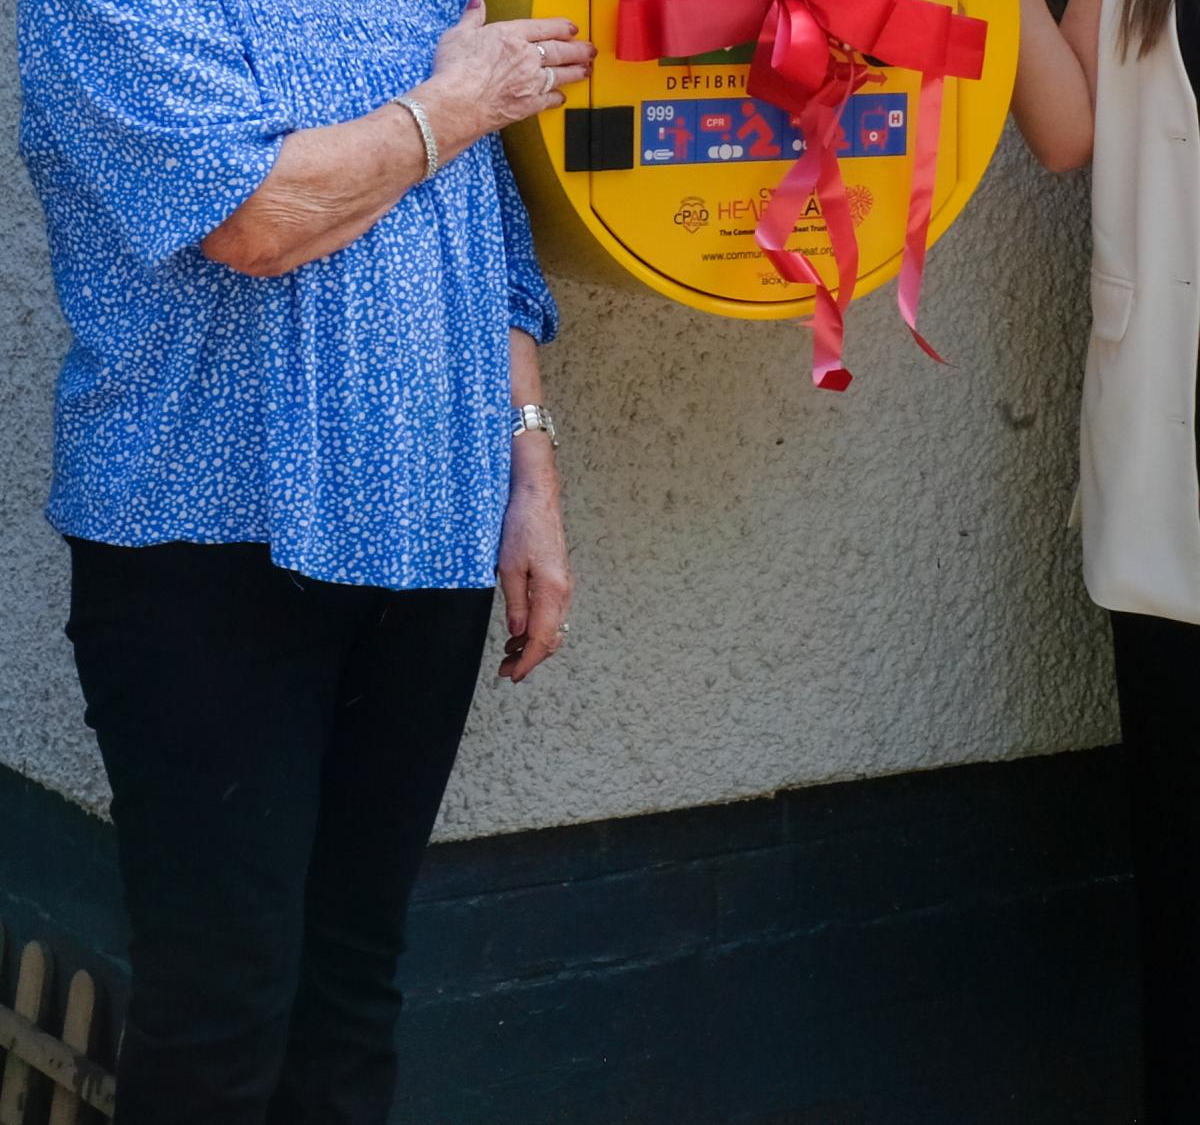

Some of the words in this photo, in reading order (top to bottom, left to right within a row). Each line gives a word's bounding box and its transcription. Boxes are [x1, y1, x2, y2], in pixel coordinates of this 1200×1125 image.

[666, 75, 746, 90] DEFIBRI
[647, 105, 674, 121] 999
[706, 118, 725, 127] CPR
